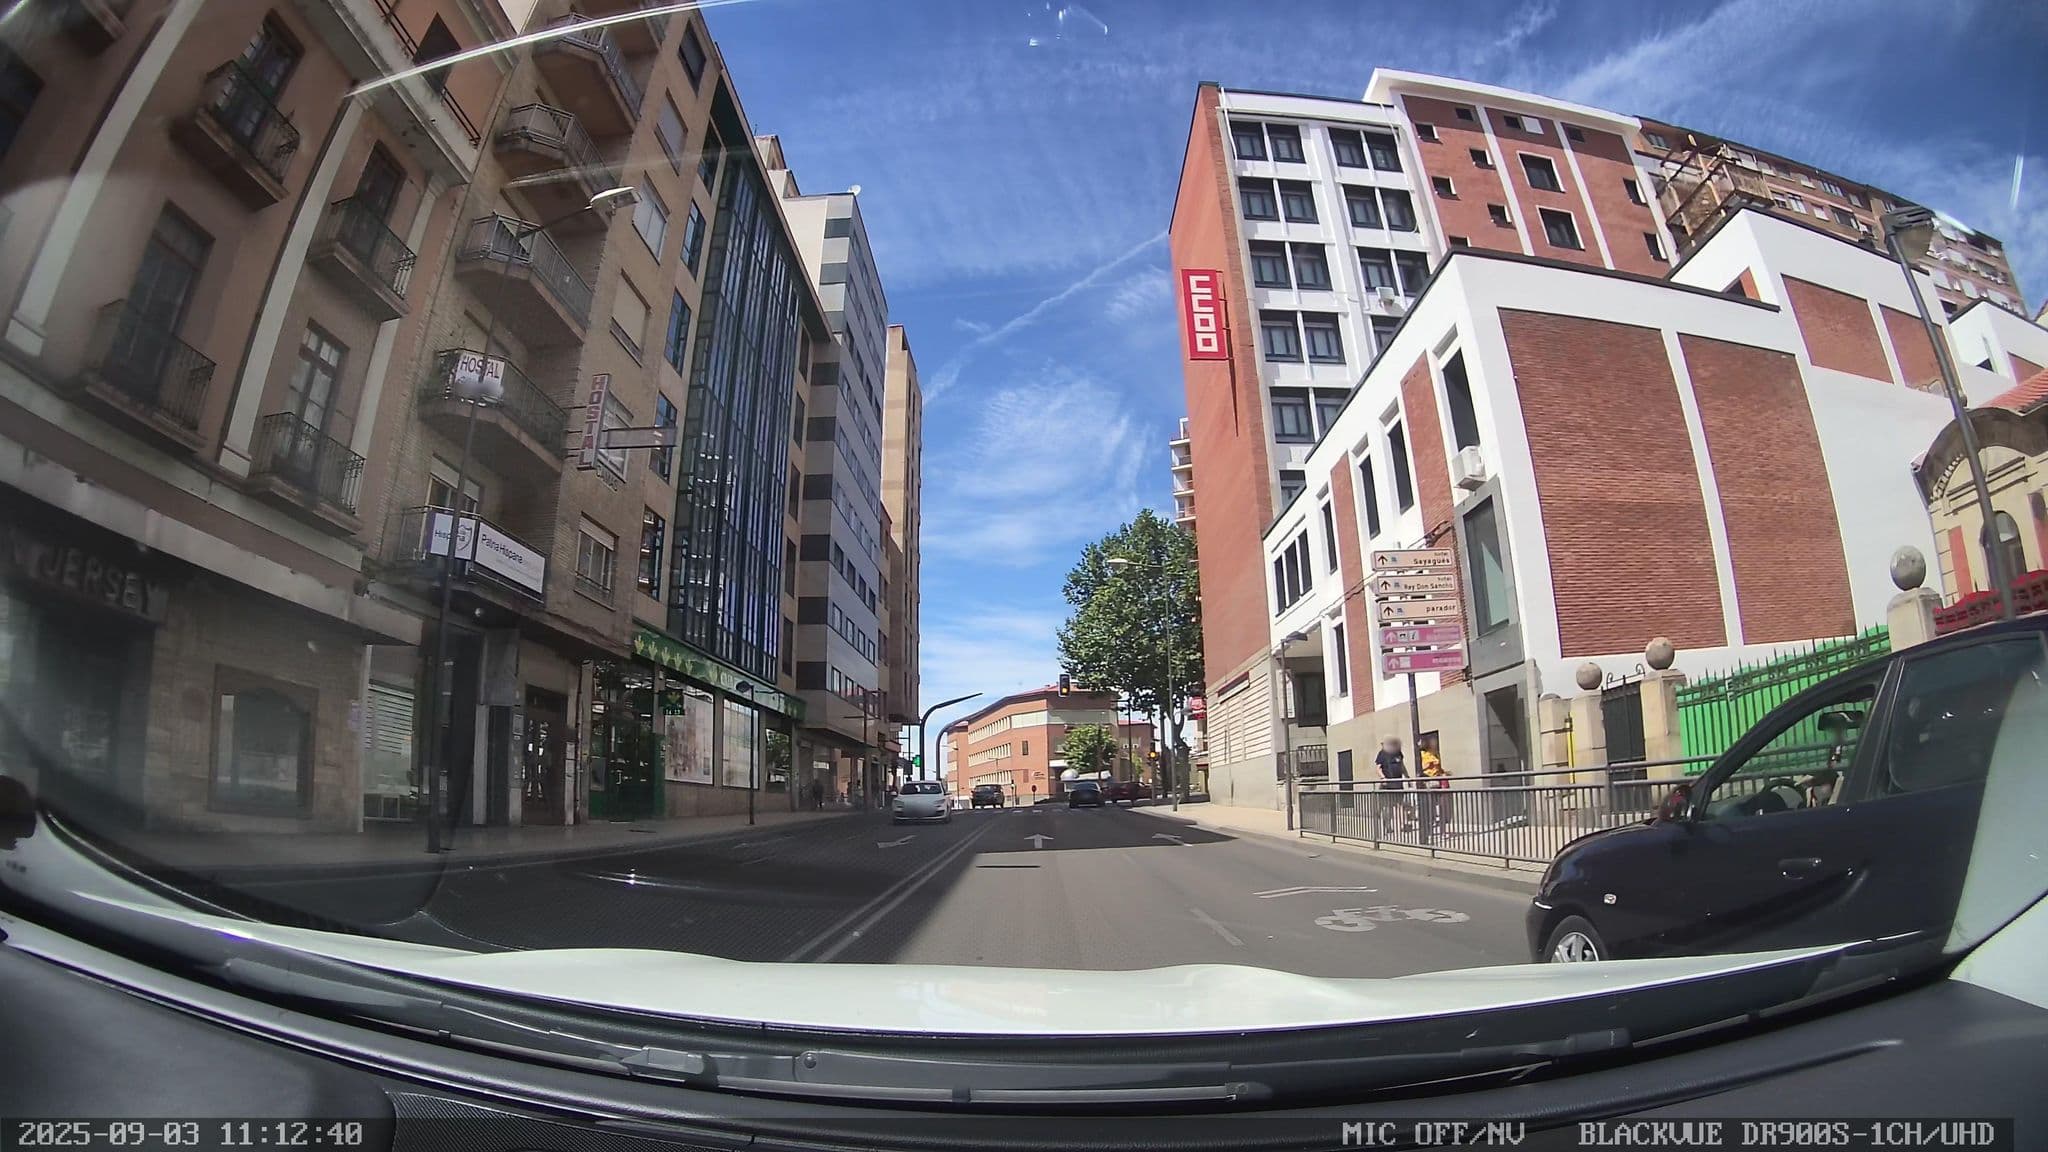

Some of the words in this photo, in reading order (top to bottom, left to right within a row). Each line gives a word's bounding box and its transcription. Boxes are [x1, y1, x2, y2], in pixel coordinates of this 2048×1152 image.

[1189, 275, 1219, 352] CCOO
[579, 376, 605, 466] HOSTAL
[1426, 604, 1456, 613] parador
